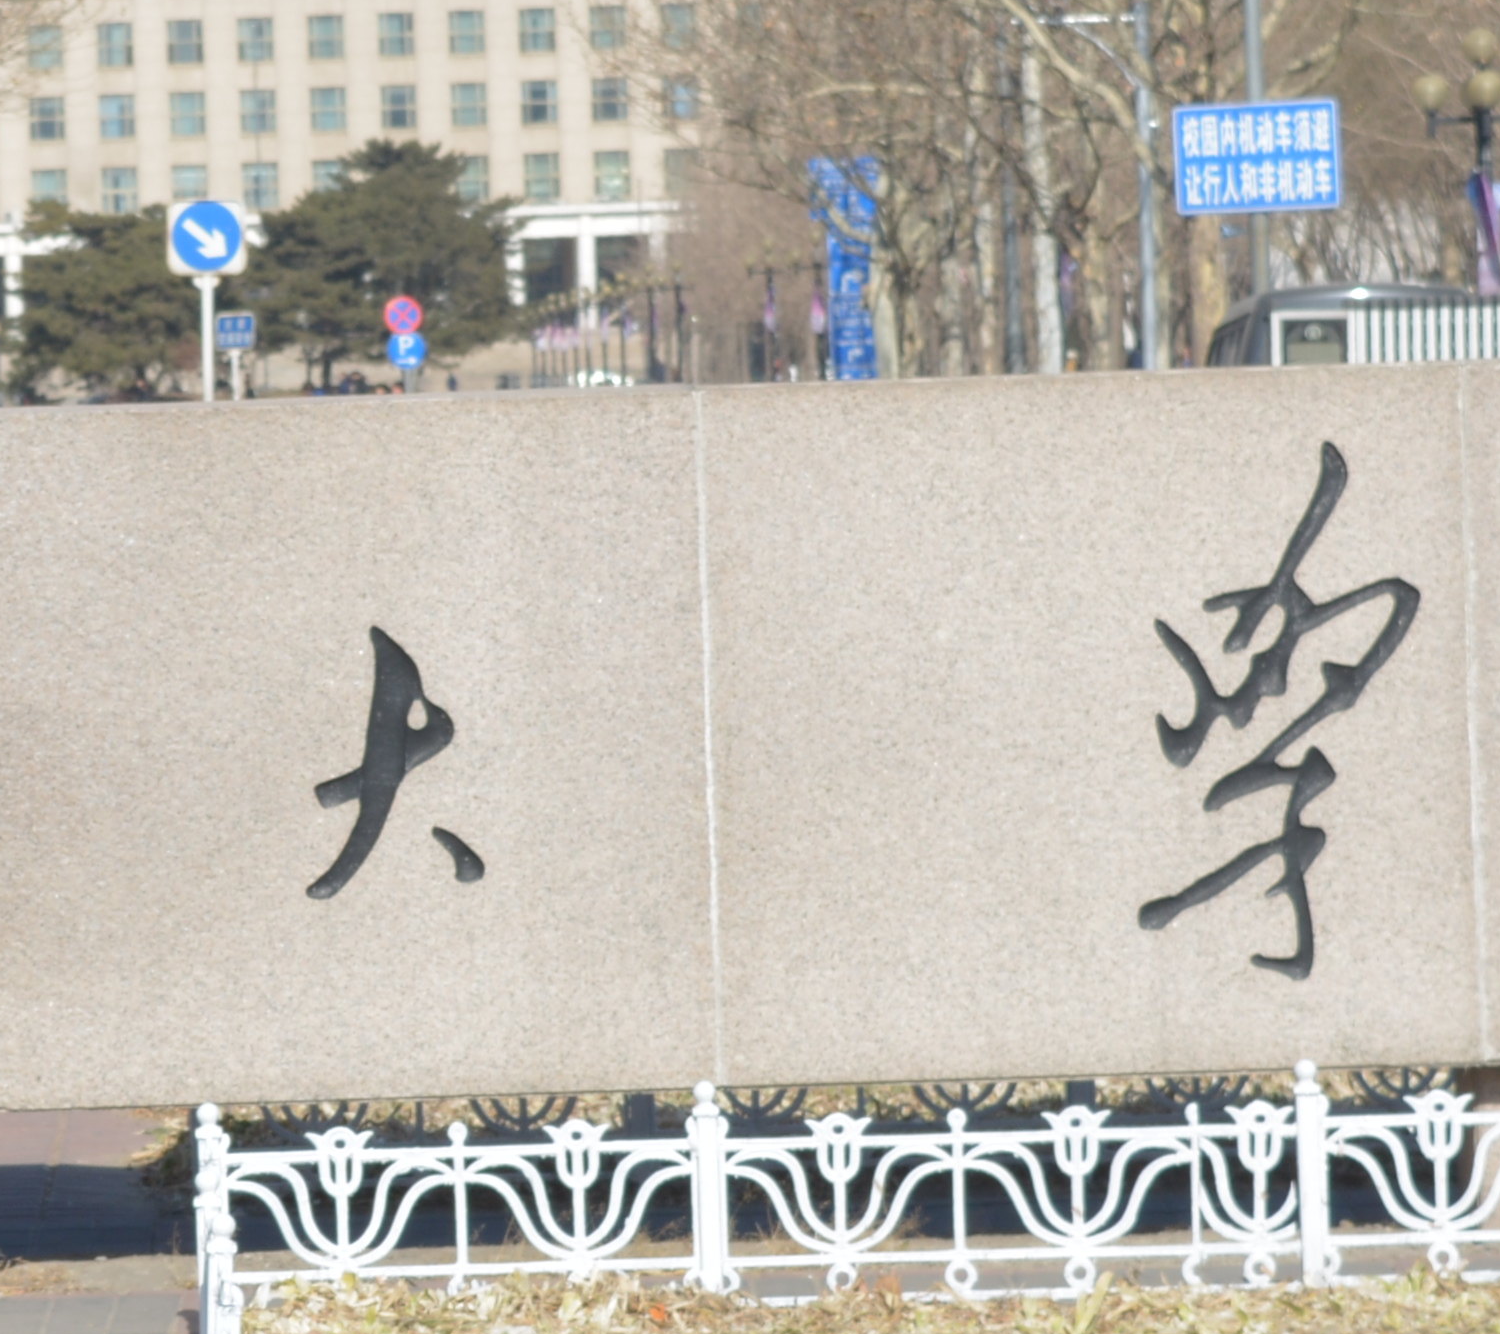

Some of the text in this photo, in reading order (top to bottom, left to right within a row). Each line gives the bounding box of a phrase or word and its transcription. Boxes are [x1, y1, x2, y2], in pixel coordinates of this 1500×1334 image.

[1182, 109, 1330, 158] 校园内机动车须避
[1184, 158, 1332, 206] 让行人和非机动车
[399, 336, 413, 356] P
